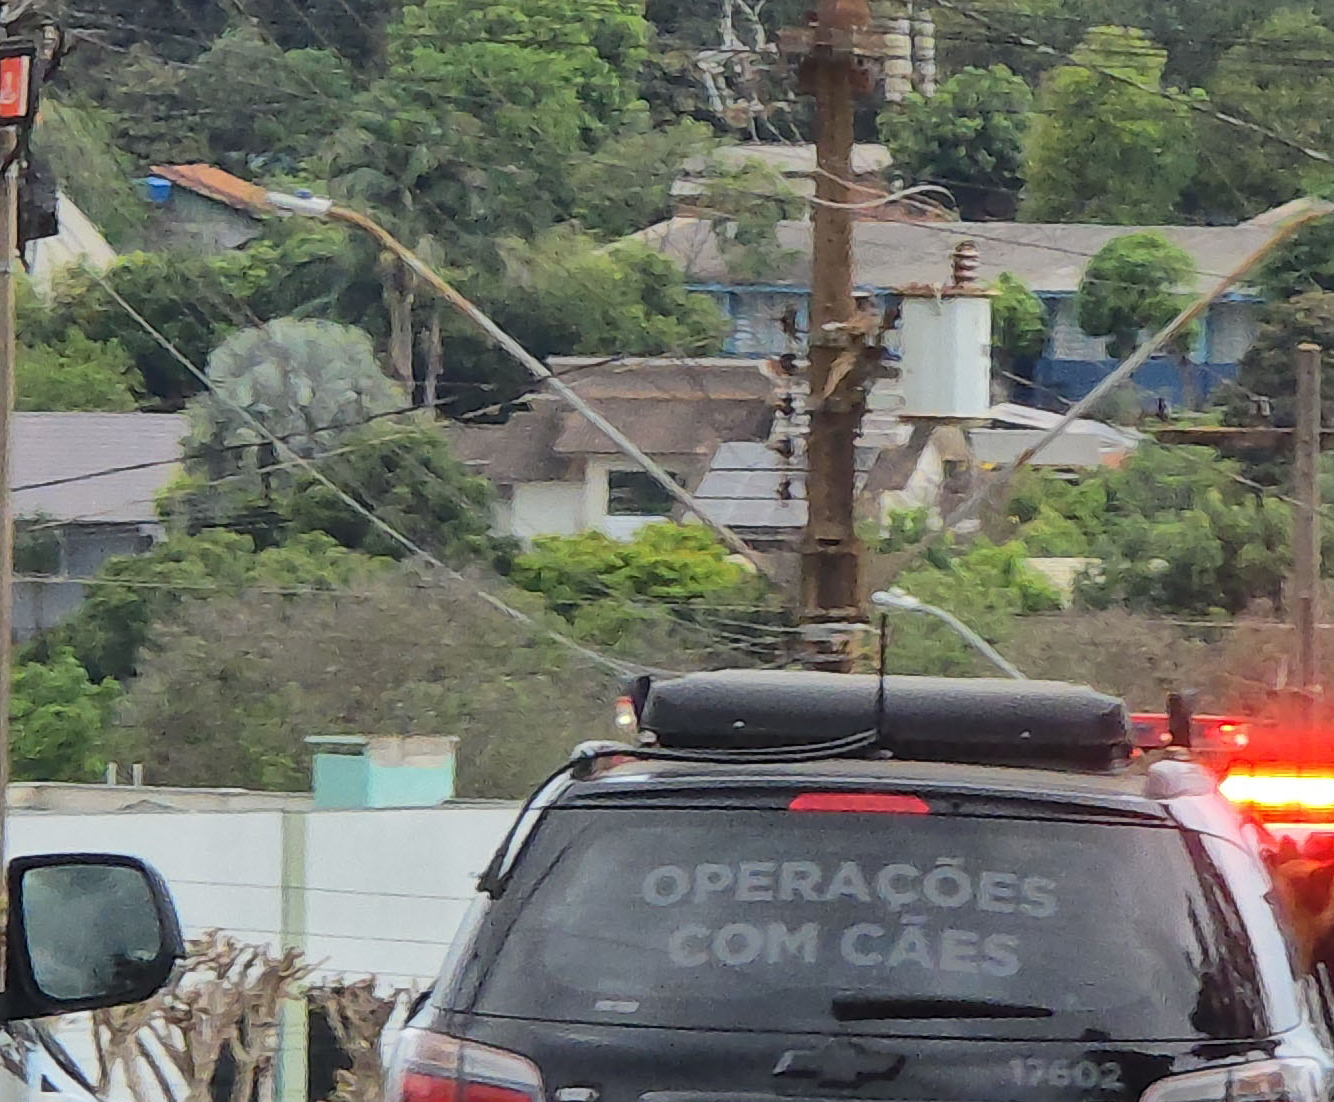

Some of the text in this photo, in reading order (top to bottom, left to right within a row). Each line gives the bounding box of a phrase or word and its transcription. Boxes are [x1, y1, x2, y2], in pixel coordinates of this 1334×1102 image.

[642, 856, 1058, 918] OPERAÇÕES
[669, 914, 1022, 978] COM CÃES
[1008, 1058, 1126, 1089] 17602
